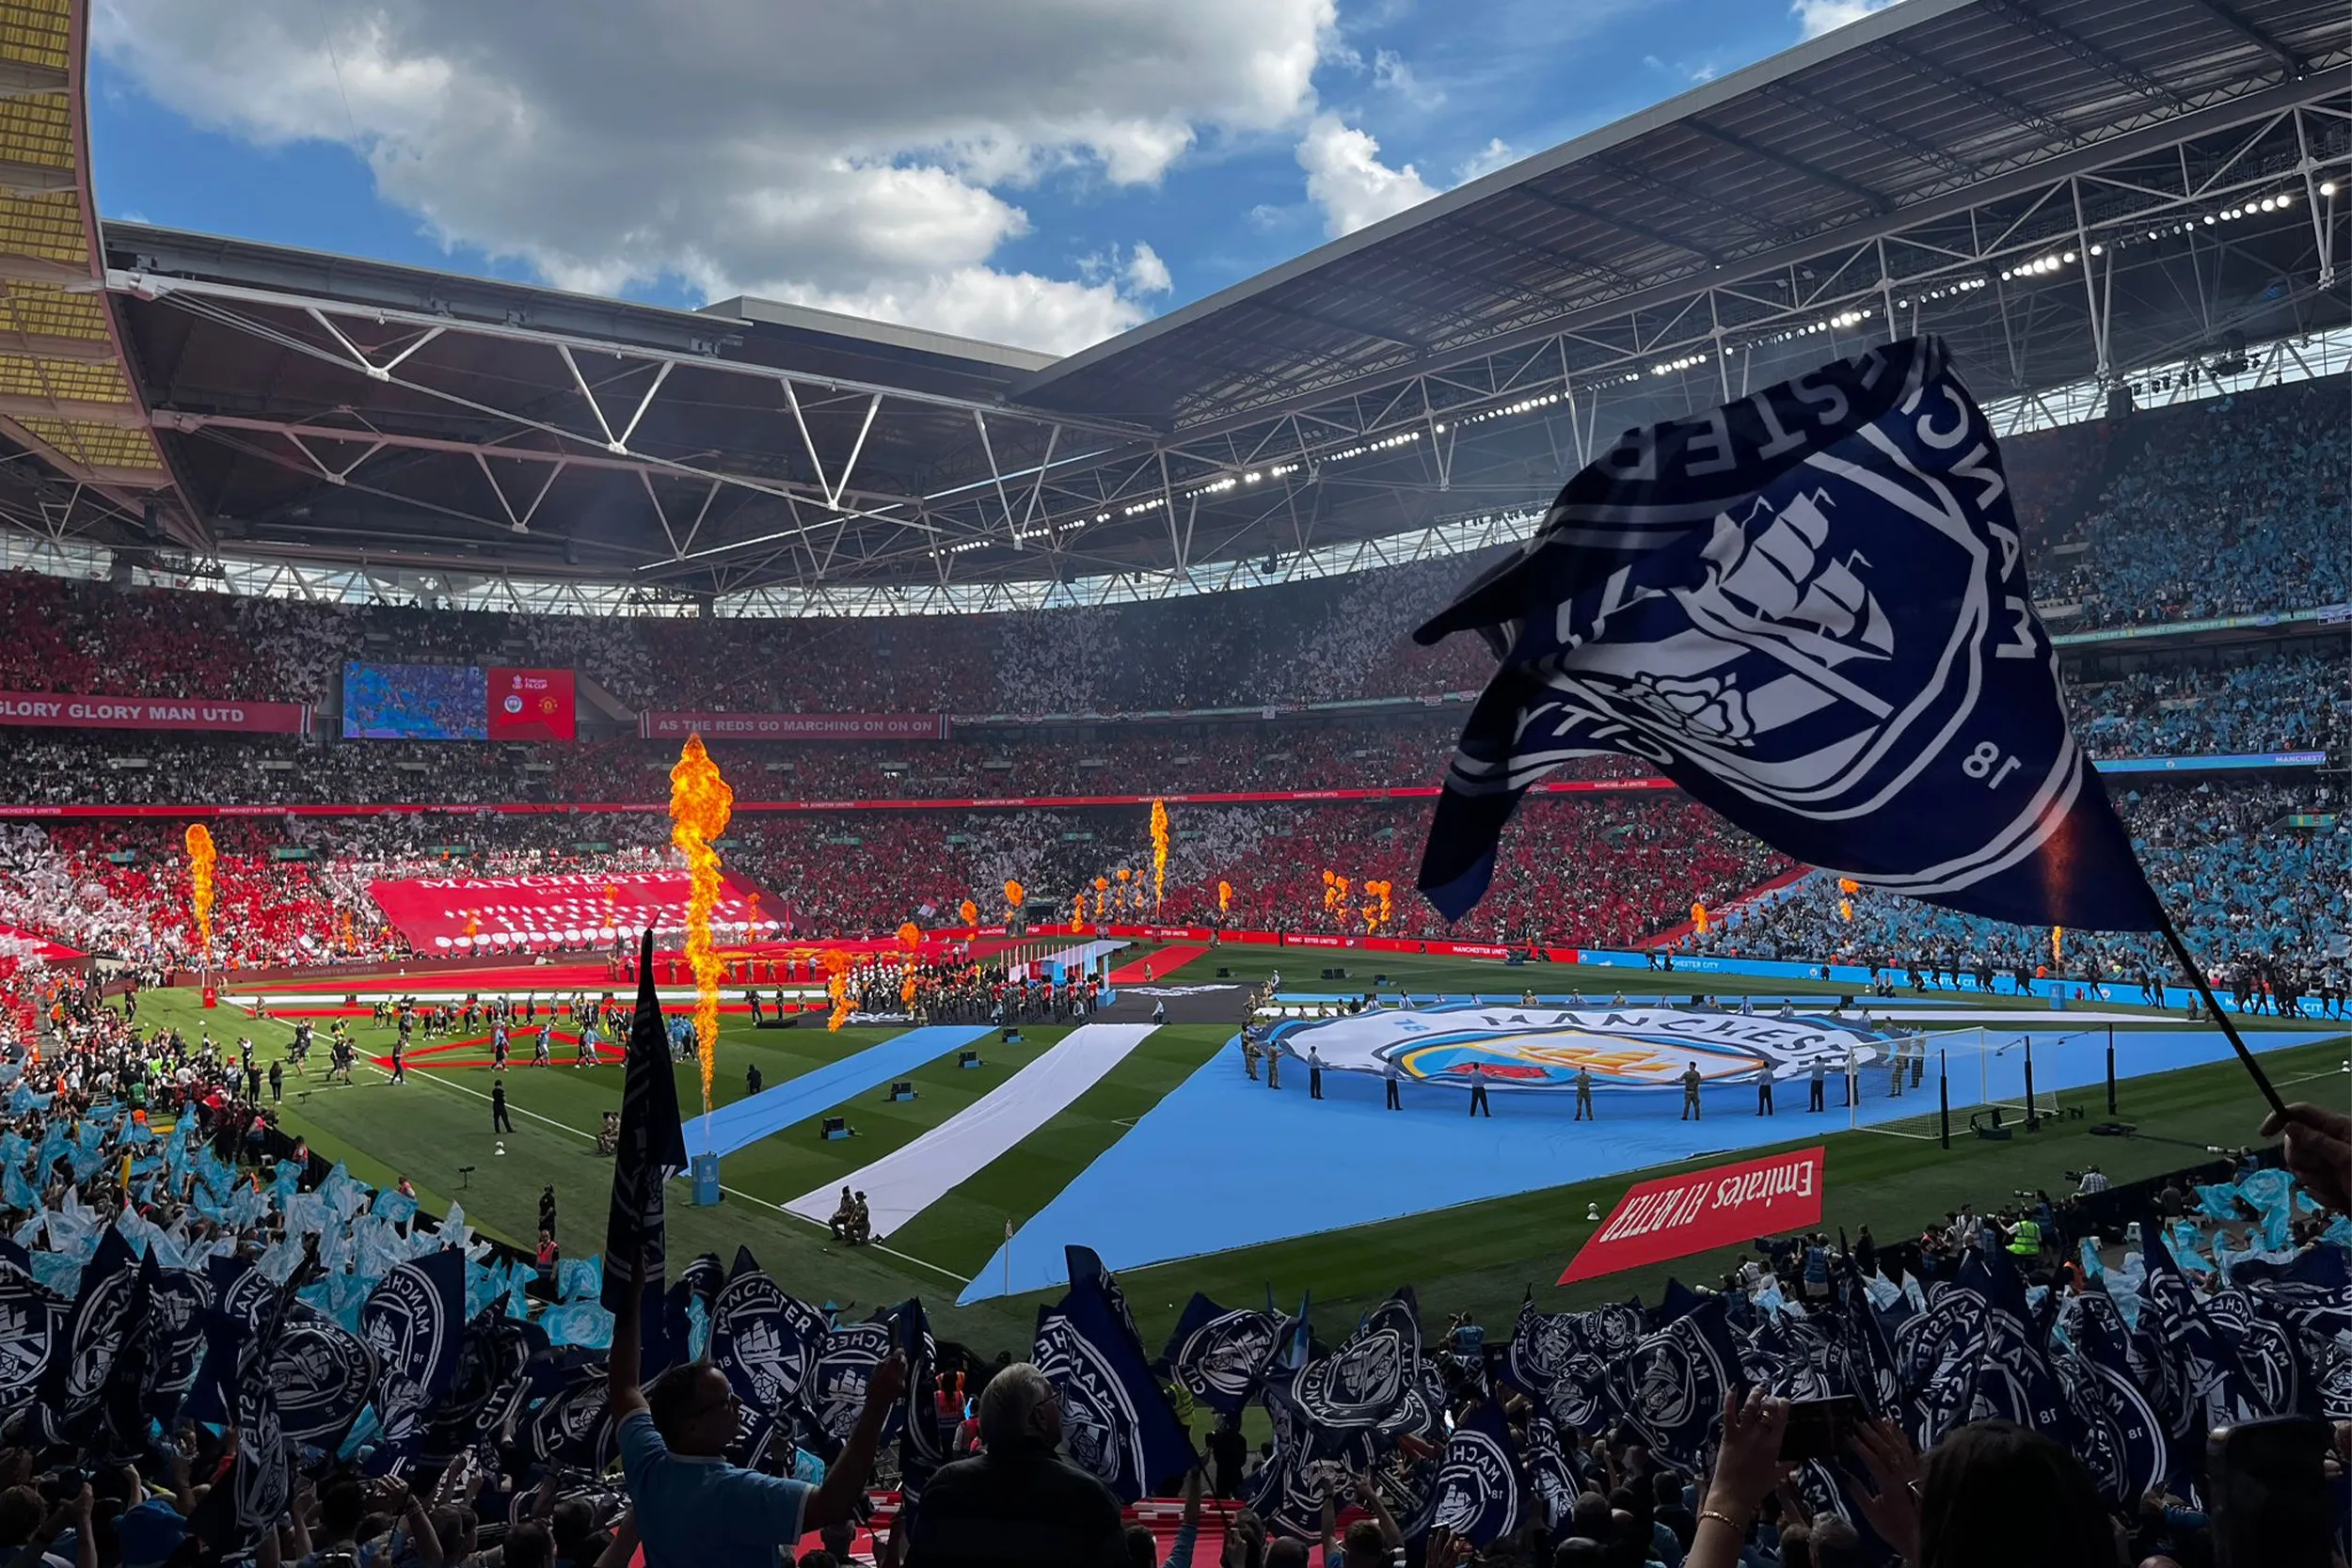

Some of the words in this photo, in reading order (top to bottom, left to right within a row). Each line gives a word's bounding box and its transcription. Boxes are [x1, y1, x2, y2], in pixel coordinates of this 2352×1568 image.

[69, 705, 143, 721] GLORY
[149, 706, 197, 721] MAN
[202, 707, 246, 723] UTD
[659, 720, 678, 732] AS
[683, 720, 711, 732] THE
[716, 720, 754, 732] REDS
[758, 720, 780, 732] GO
[784, 720, 859, 732] MARCHING
[863, 720, 884, 732] ON
[887, 720, 909, 732] ON
[912, 720, 932, 732] ON
[2275, 754, 2327, 763] MANCHEST
[1453, 945, 1490, 954] MANCHESTER
[1702, 960, 1720, 969] CITY
[1962, 978, 1977, 987] CIT
[2303, 1003, 2323, 1012] CIT
[1711, 1160, 1814, 1211] Emirates
[1598, 1186, 1685, 1243] BETTER
[719, 1355, 733, 1370] 18
[1401, 1341, 1414, 1388] CITY
[0, 1384, 40, 1405] ITY
[475, 1378, 516, 1430] CITY
